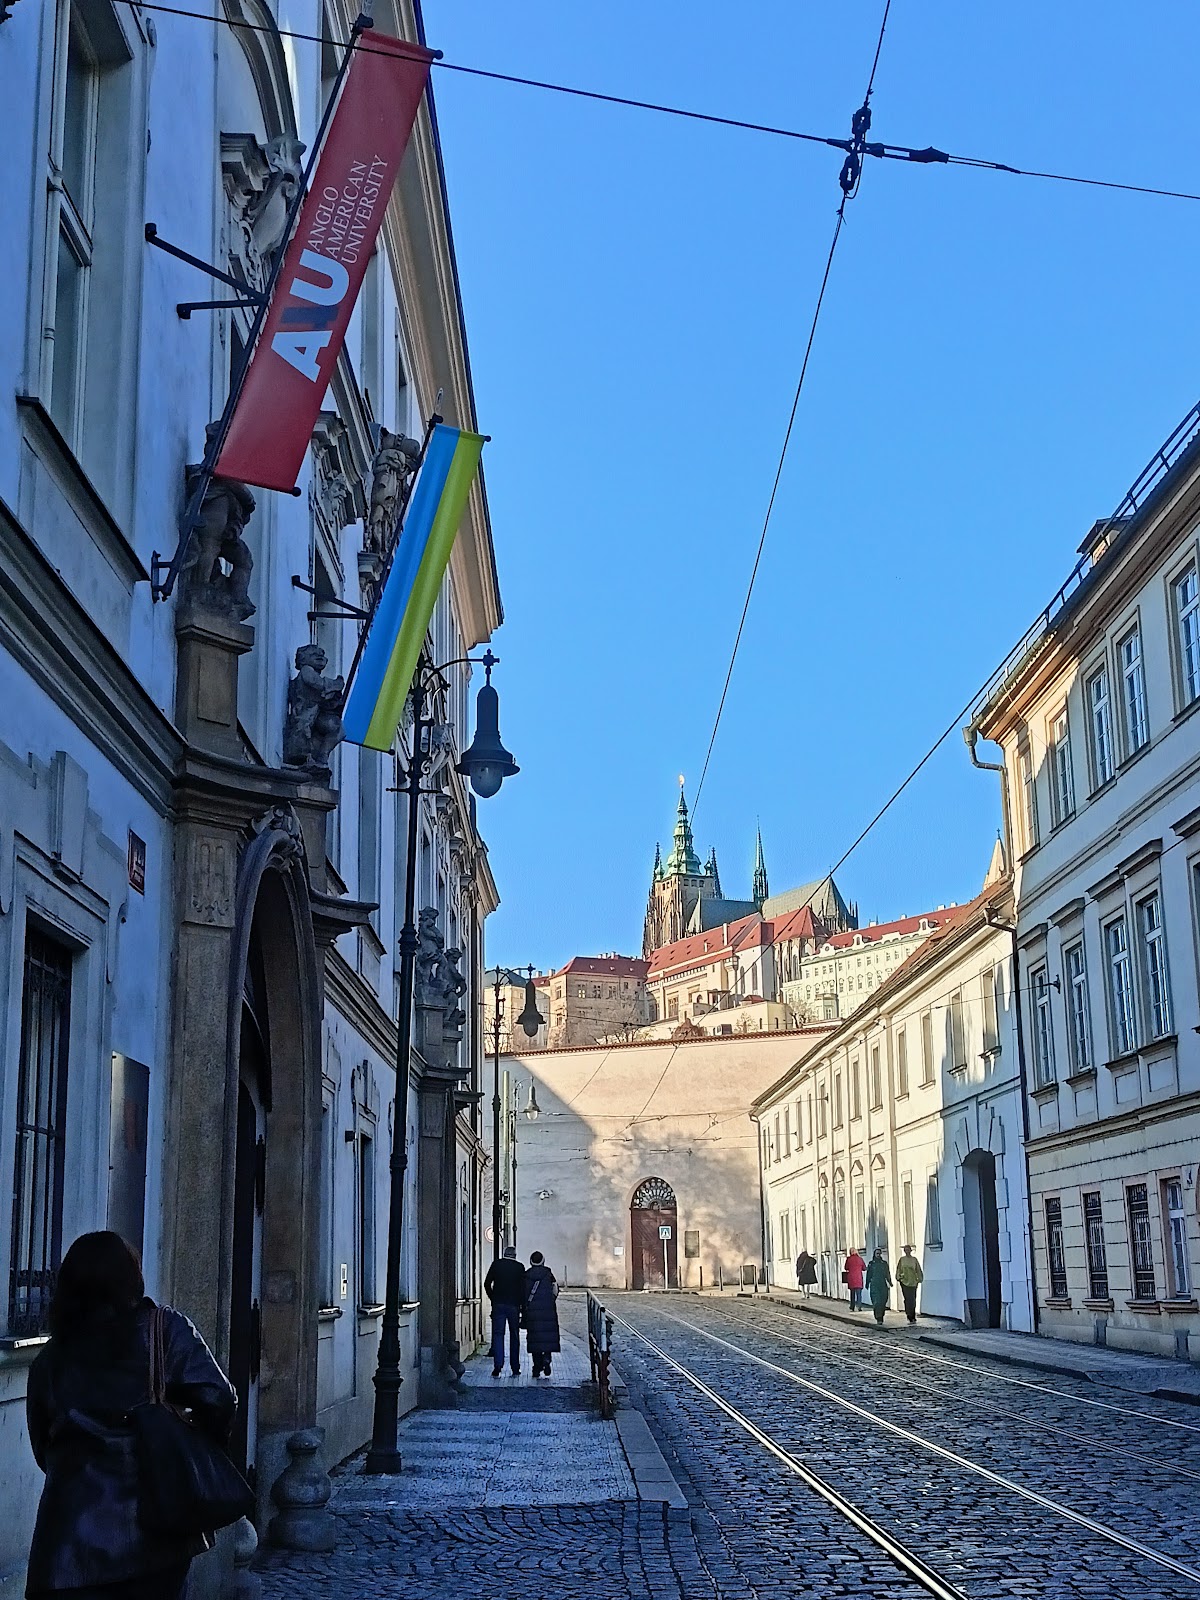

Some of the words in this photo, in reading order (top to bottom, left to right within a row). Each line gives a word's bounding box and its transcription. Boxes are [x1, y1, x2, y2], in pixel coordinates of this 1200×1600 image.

[312, 185, 339, 252] ANGLO
[327, 160, 368, 260] AMERICAN
[340, 154, 389, 264] UNIVERSITY
